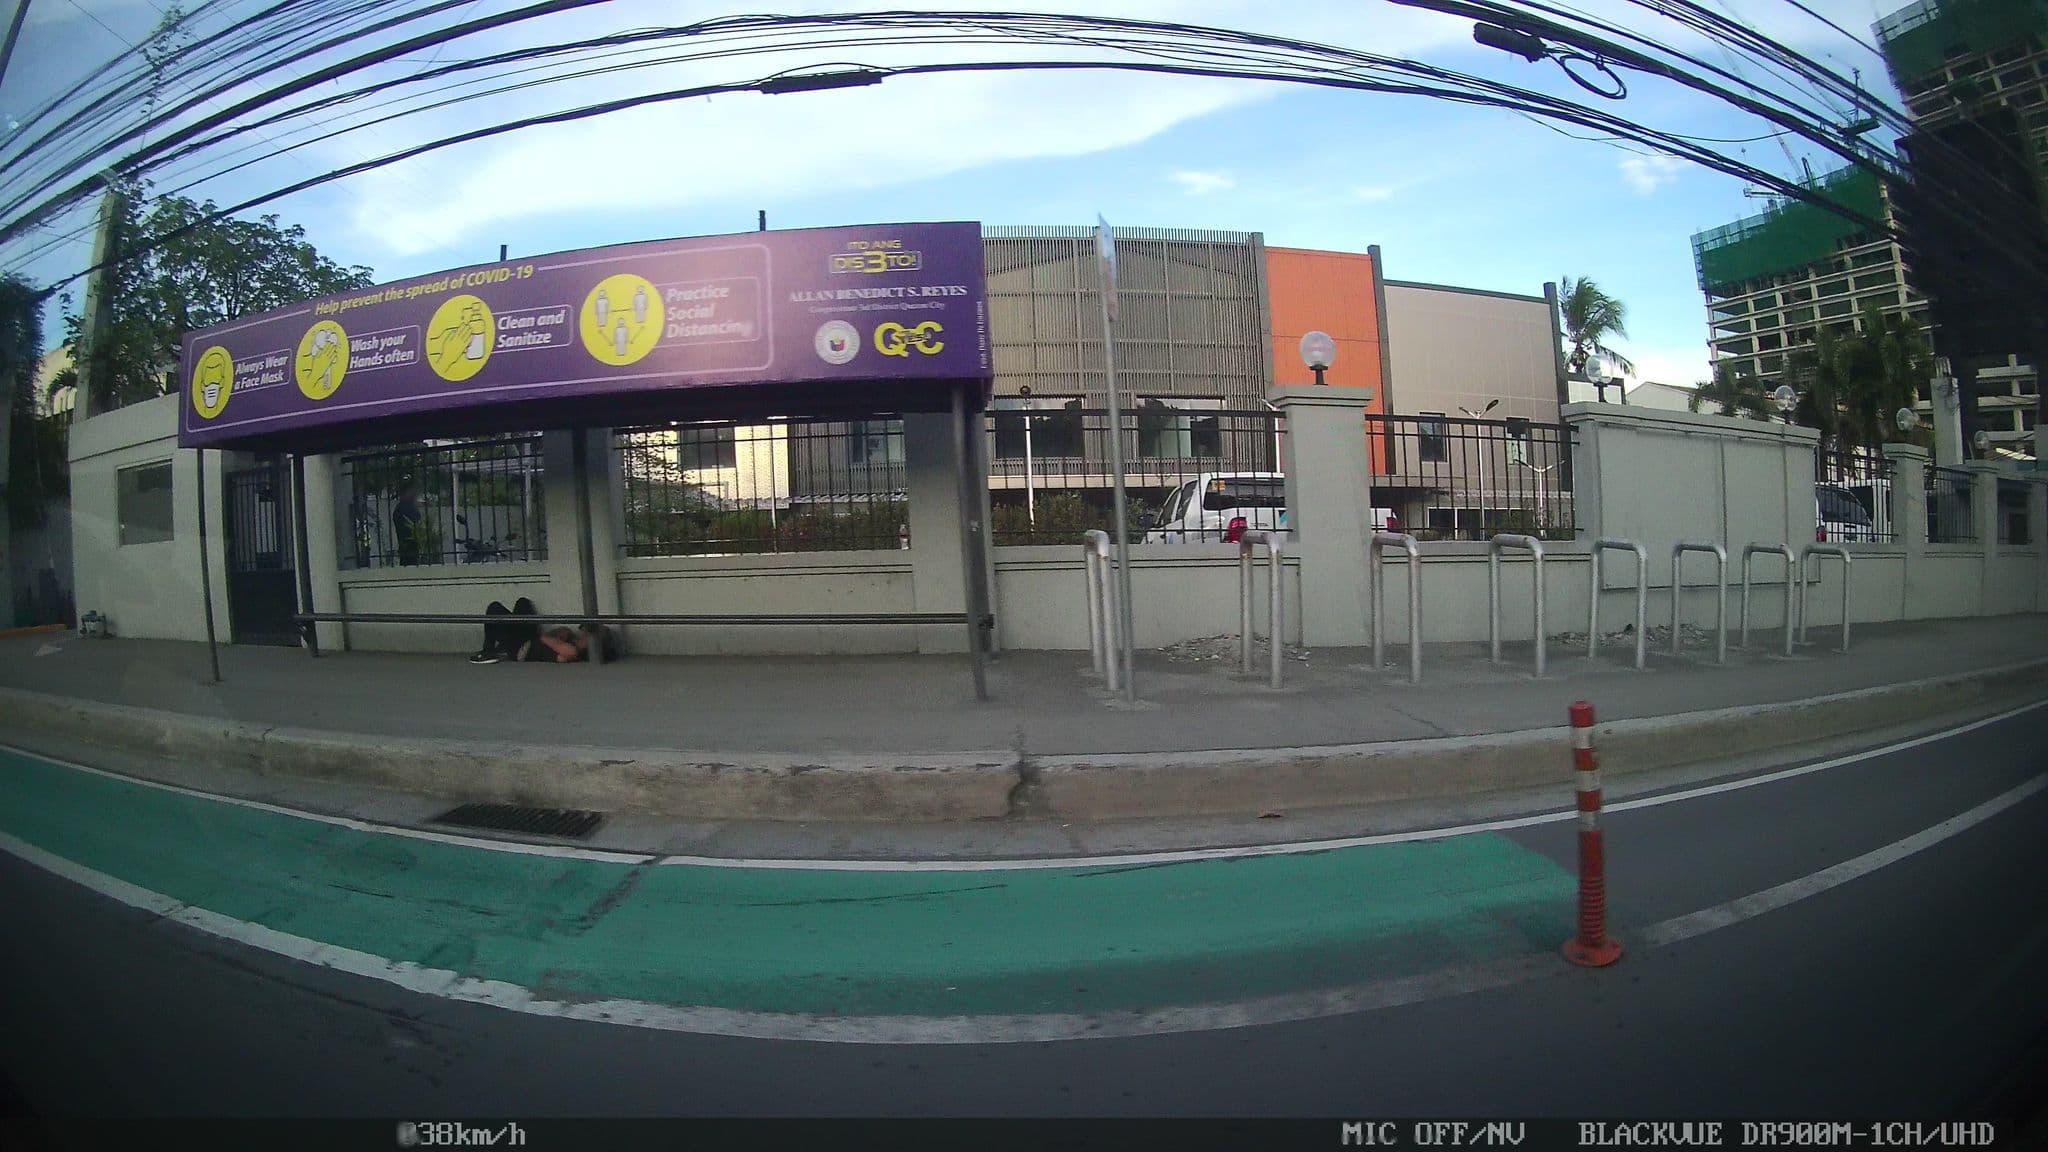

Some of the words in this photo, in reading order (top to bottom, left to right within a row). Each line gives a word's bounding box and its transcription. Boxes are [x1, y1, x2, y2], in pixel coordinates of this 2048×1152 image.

[874, 239, 902, 249] ANG
[315, 299, 340, 316] Help
[340, 290, 383, 310] prevent
[385, 286, 405, 301] the
[405, 279, 449, 298] spread
[450, 275, 466, 291] of
[466, 264, 534, 287] COVID-19
[666, 285, 730, 303] Practice
[789, 291, 834, 302] ALLAN
[835, 287, 904, 300] BENEDICT
[907, 286, 921, 297] S.
[922, 285, 968, 297] REYES
[498, 315, 535, 330] Clean
[537, 309, 566, 326] and
[667, 303, 715, 321] Social
[666, 321, 753, 338] Distancing
[351, 336, 379, 352] Wash
[379, 334, 407, 351] your
[496, 331, 552, 348] Sanitize
[235, 361, 265, 376] Always
[265, 356, 289, 369] Wear
[350, 352, 384, 369] Hands
[385, 348, 415, 363] often
[234, 381, 241, 390] a
[241, 376, 260, 389] Face
[260, 369, 285, 385] Mask
